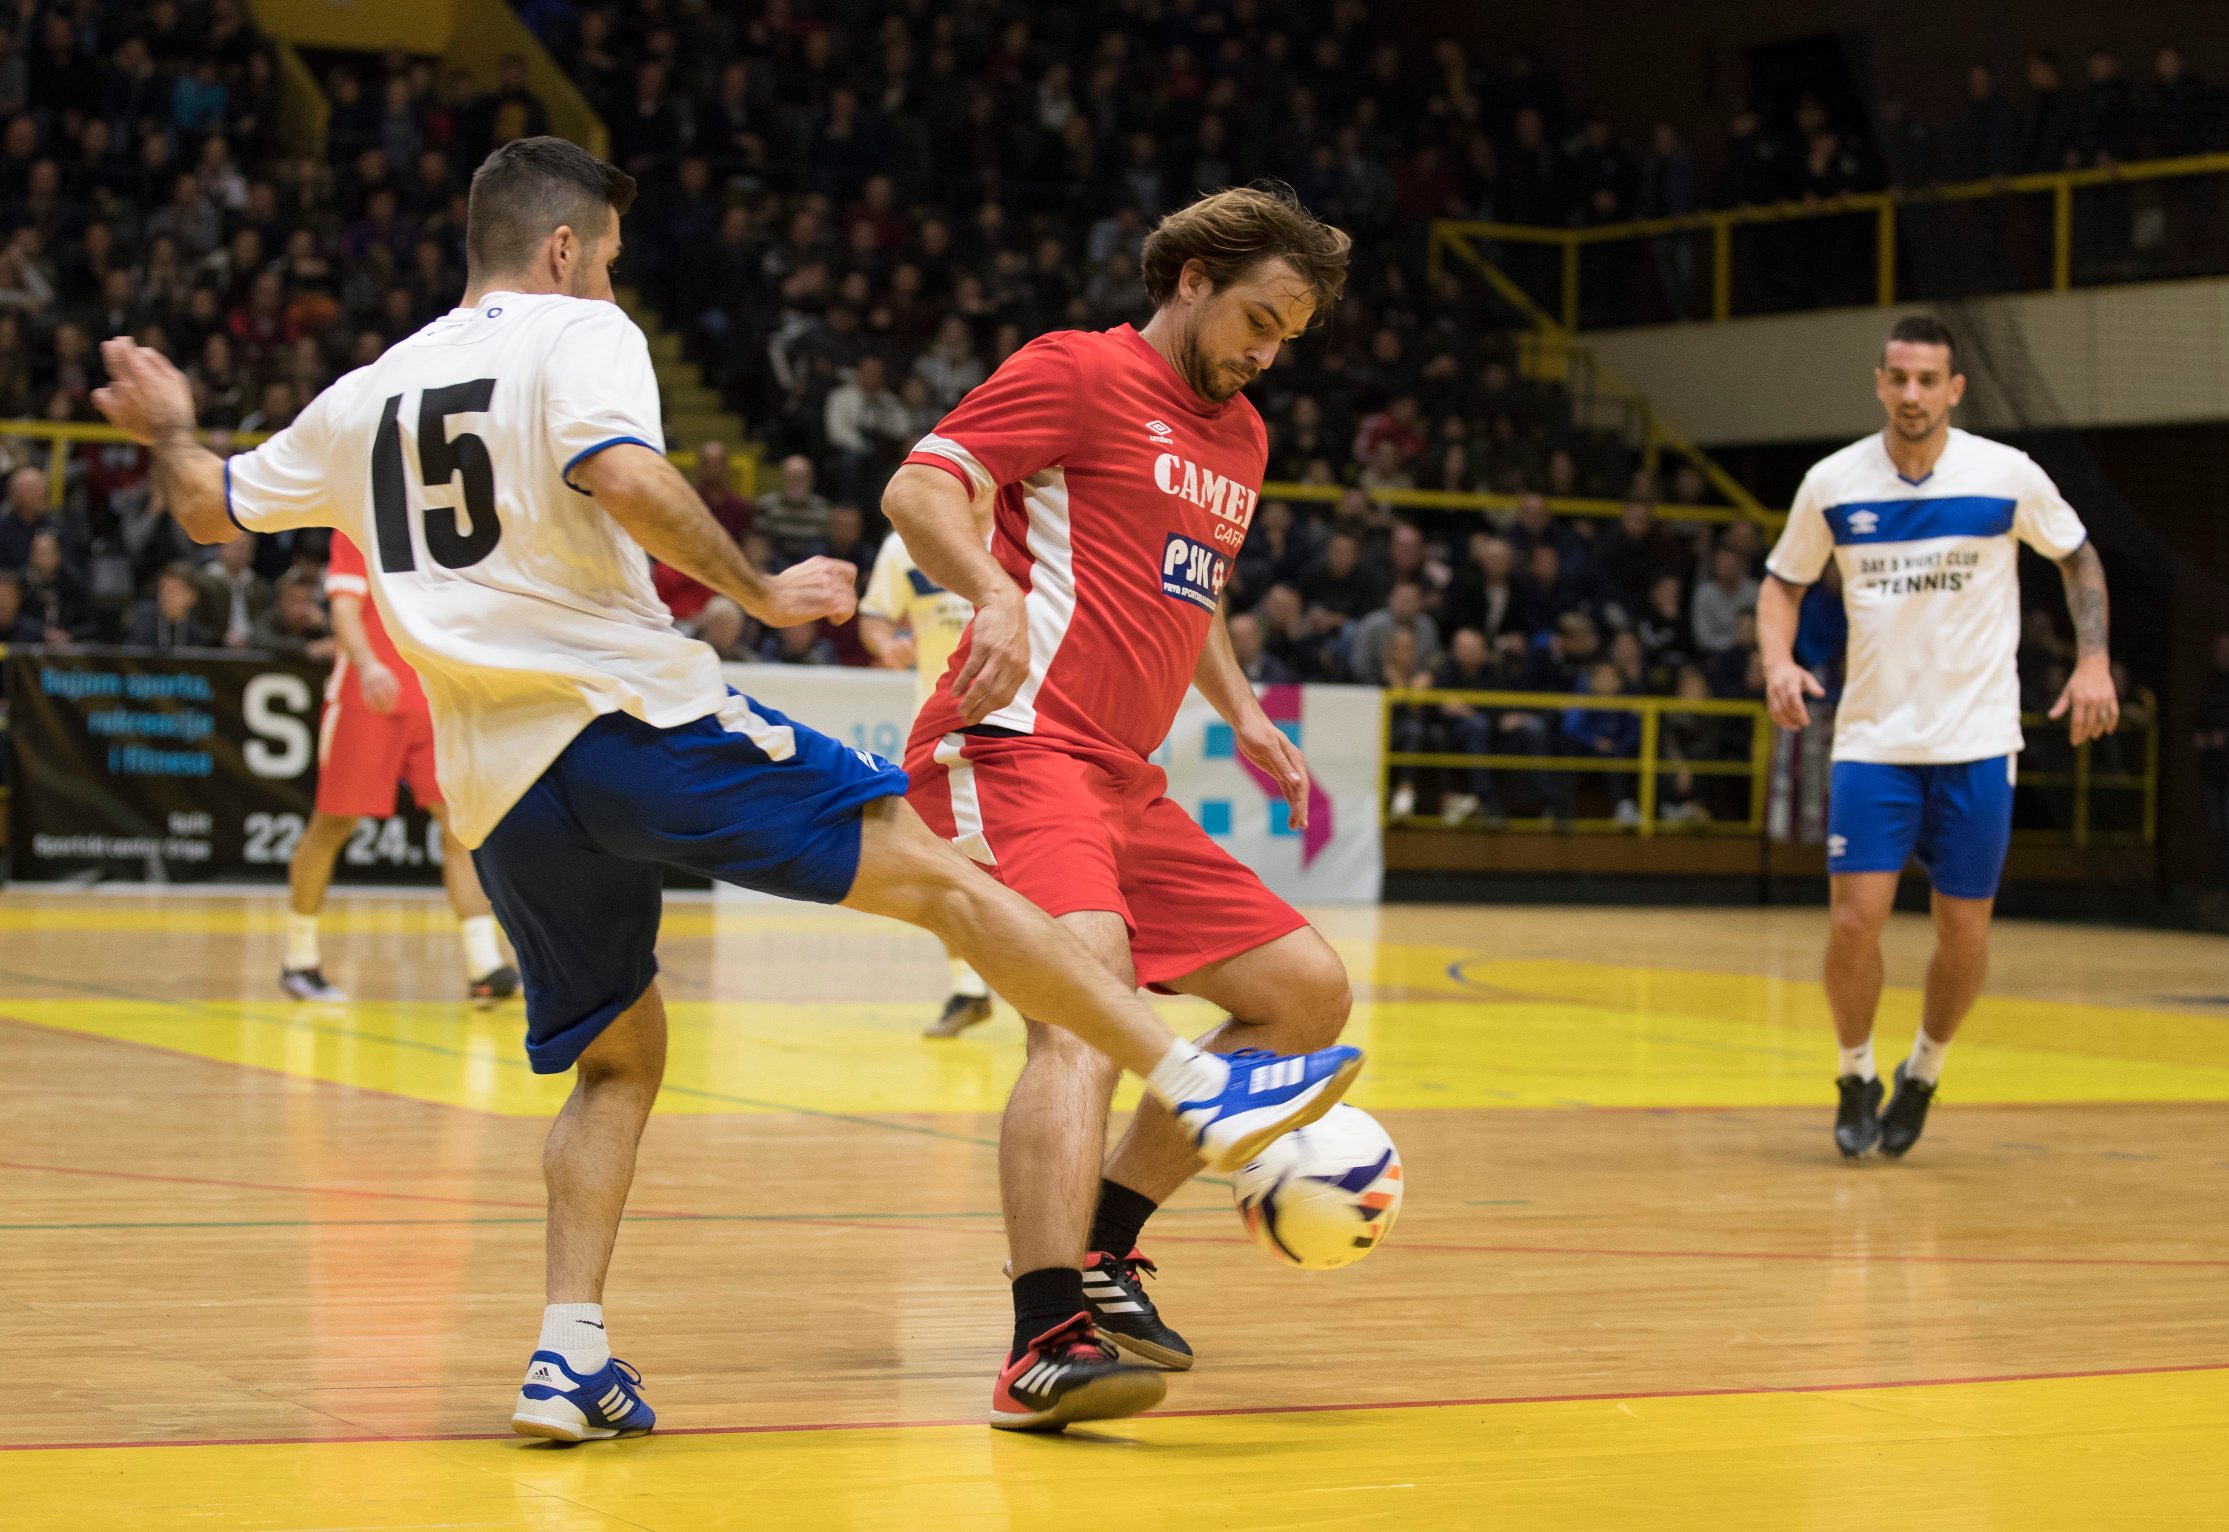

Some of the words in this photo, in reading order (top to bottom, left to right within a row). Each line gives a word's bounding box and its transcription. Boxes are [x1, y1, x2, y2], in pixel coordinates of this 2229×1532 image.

[1149, 435, 1174, 445] umbro
[372, 378, 502, 573] 15
[1163, 538, 1212, 589] PSK
[1861, 558, 1885, 574] DAY
[1904, 552, 1941, 569] NIGHT
[1946, 550, 1979, 567] CLUB
